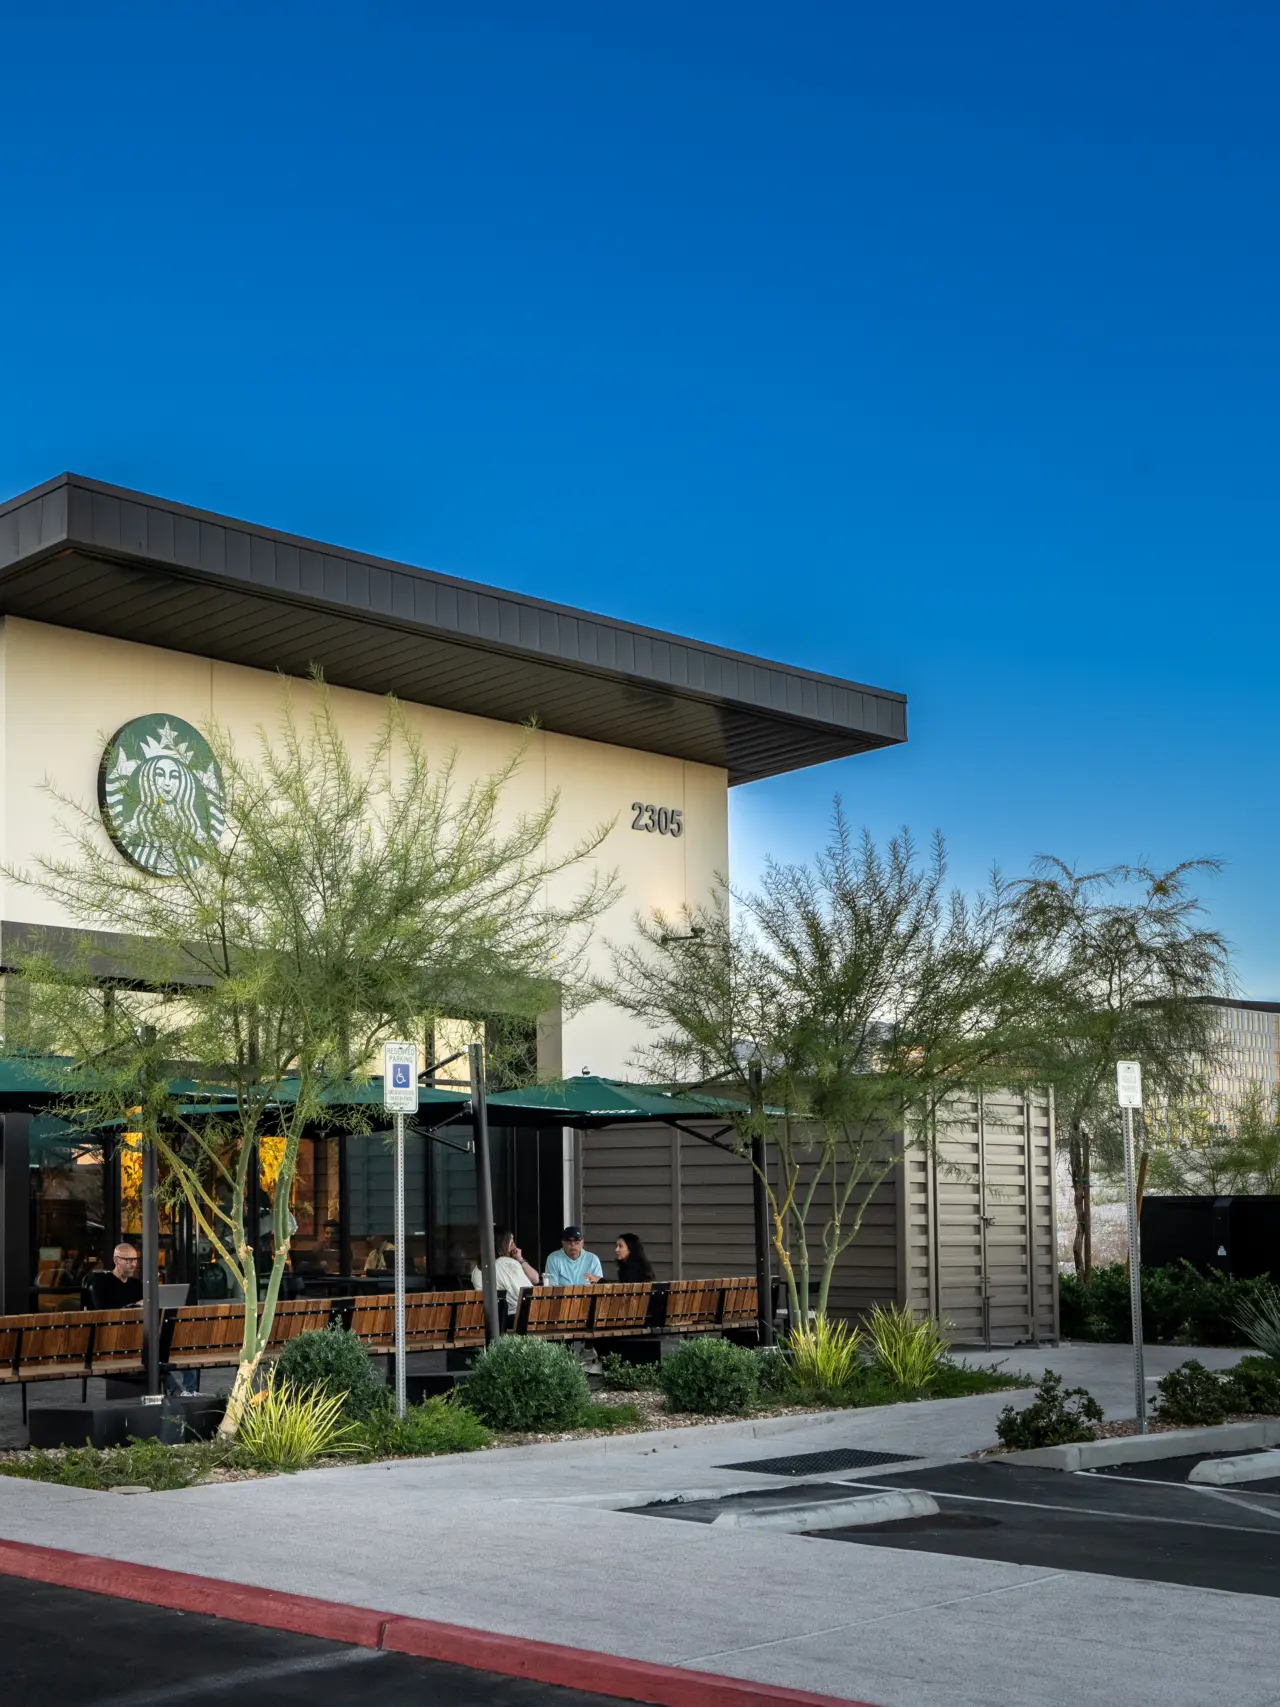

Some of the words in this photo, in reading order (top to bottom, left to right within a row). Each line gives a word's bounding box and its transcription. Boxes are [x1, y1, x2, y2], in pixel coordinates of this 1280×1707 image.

[631, 801, 683, 838] 2305
[387, 1047, 415, 1056] RESERVED
[389, 1055, 413, 1063] PARKING
